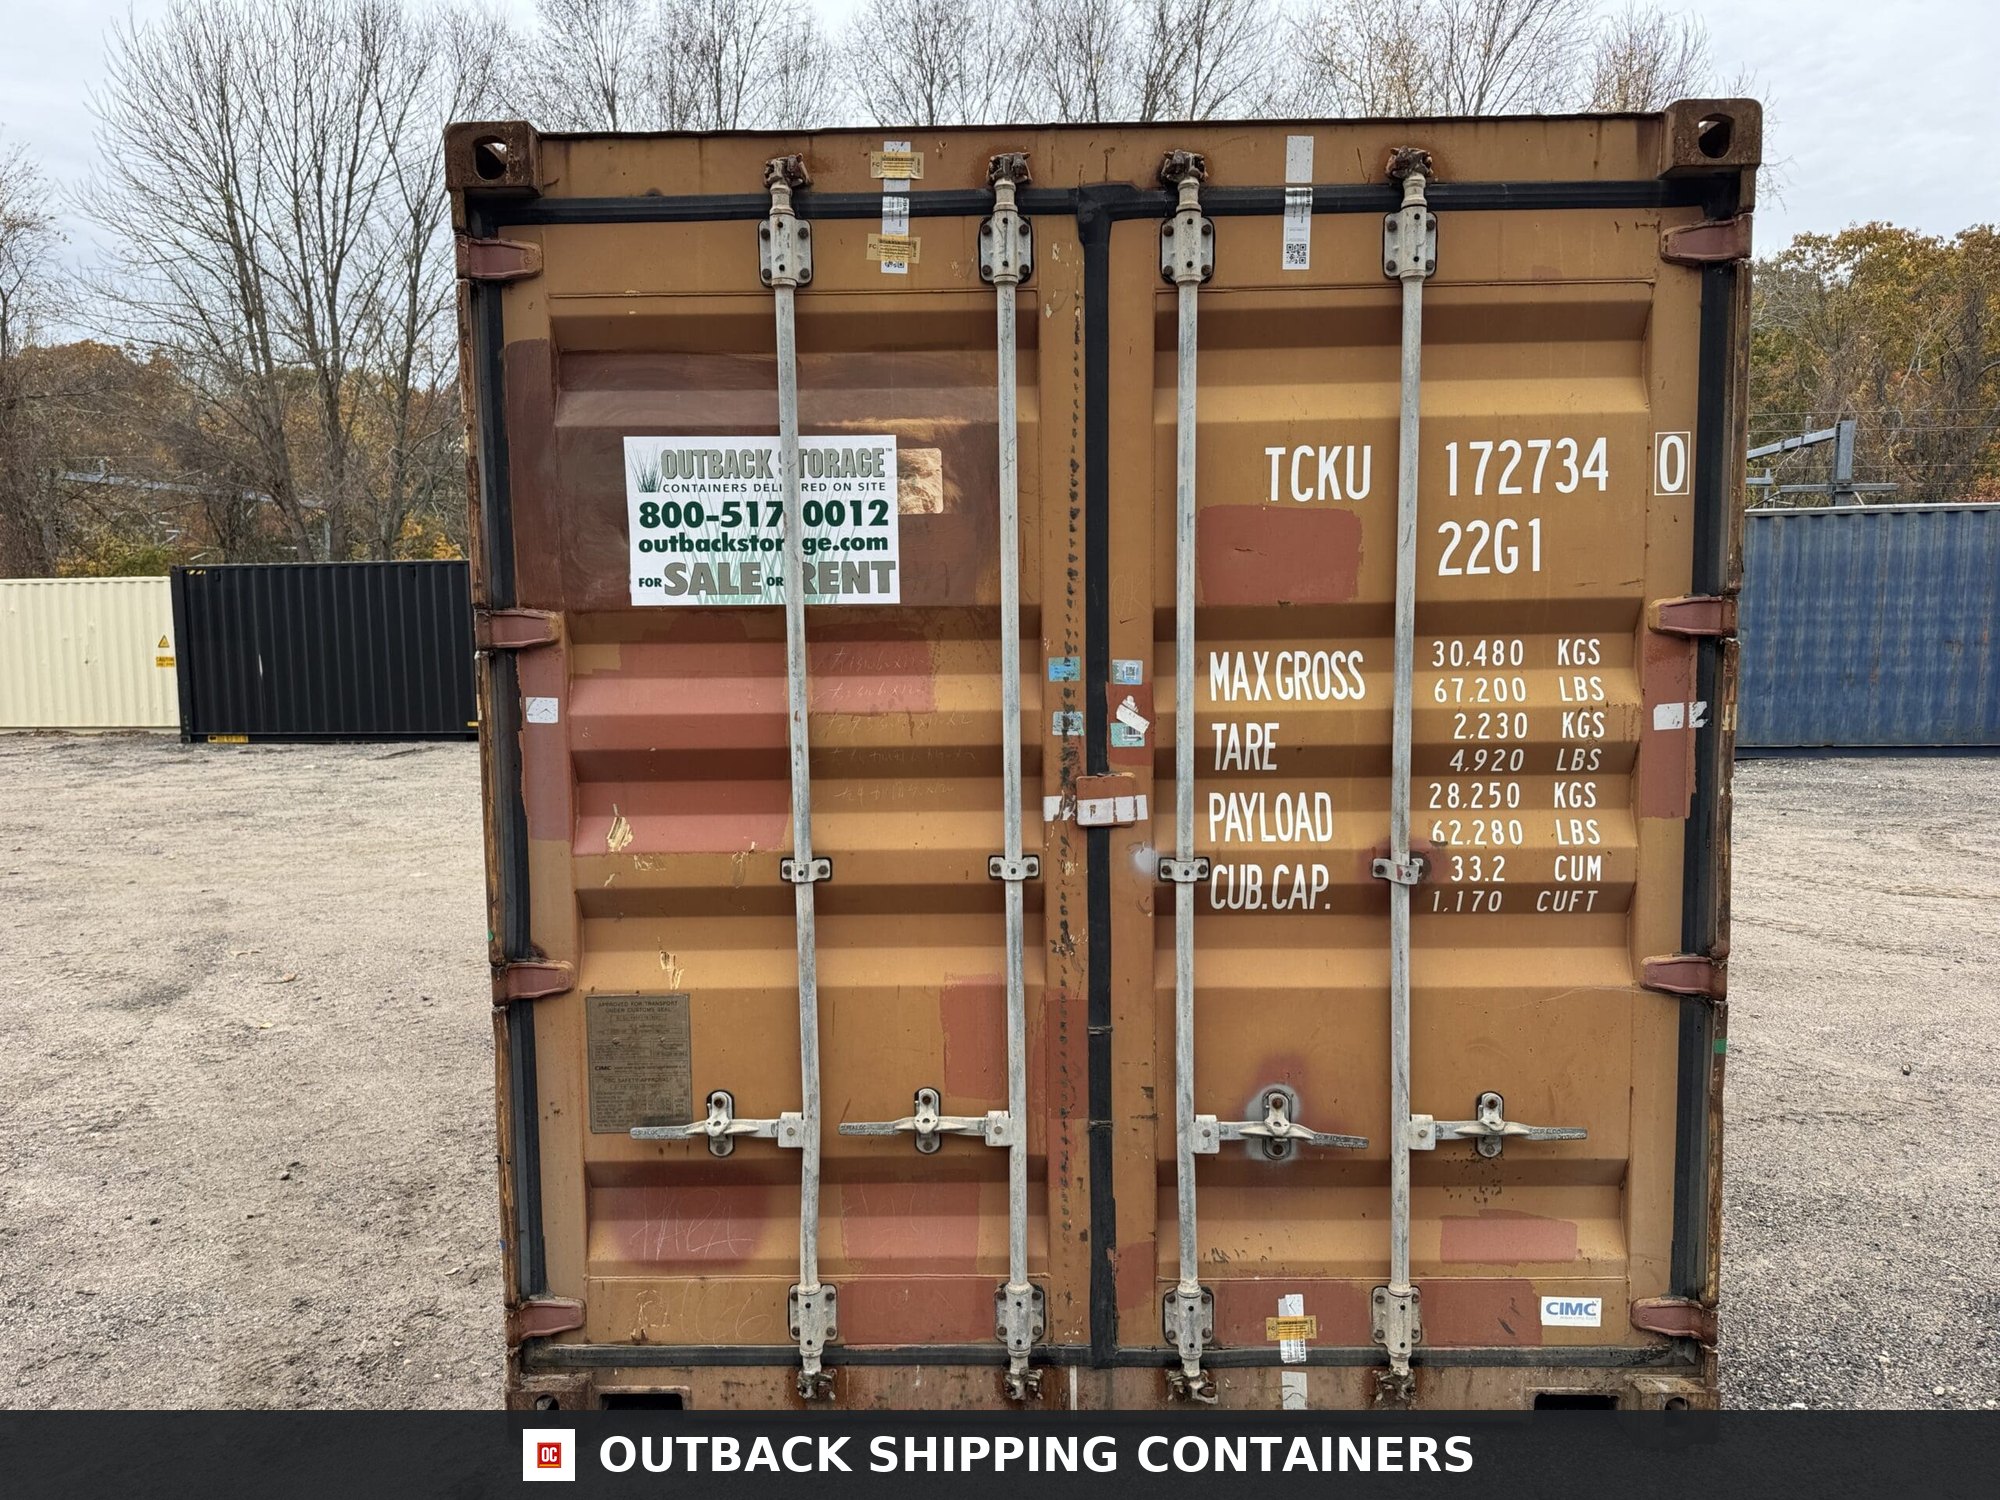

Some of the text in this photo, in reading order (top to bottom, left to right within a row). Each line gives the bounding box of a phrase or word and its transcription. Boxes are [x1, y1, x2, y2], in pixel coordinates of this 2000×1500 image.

[661, 447, 886, 479] OUTBACK TORAGE
[1266, 445, 1371, 502] TCKU
[1445, 437, 1609, 496] 172734
[662, 482, 886, 493] CONTAINERS DELIRED ON SITE
[639, 500, 889, 528] 800-5170012
[638, 532, 889, 555] outbackstorge.com
[1438, 518, 1541, 577] 22G1
[638, 561, 896, 596] FOR SALE OR RENT
[1432, 639, 1601, 668] 30,480 KGS
[1210, 650, 1365, 702] MAX GROSS
[1434, 676, 1605, 703] 67,200 LBS
[1453, 711, 1605, 740] 2,230 KGS
[1212, 723, 1279, 771] TARE
[1449, 748, 1602, 772] 4,920 LBS
[1429, 781, 1597, 809] 28,250 KGS
[1209, 792, 1333, 843] PAYLOAD
[1431, 819, 1601, 846] 62,280 LBS
[1451, 855, 1602, 882] 33.2 CUM
[1210, 864, 1331, 910] CUB.CAP.
[1432, 890, 1598, 912] 1,170 CUFT
[1545, 1301, 1597, 1316] CIMC
